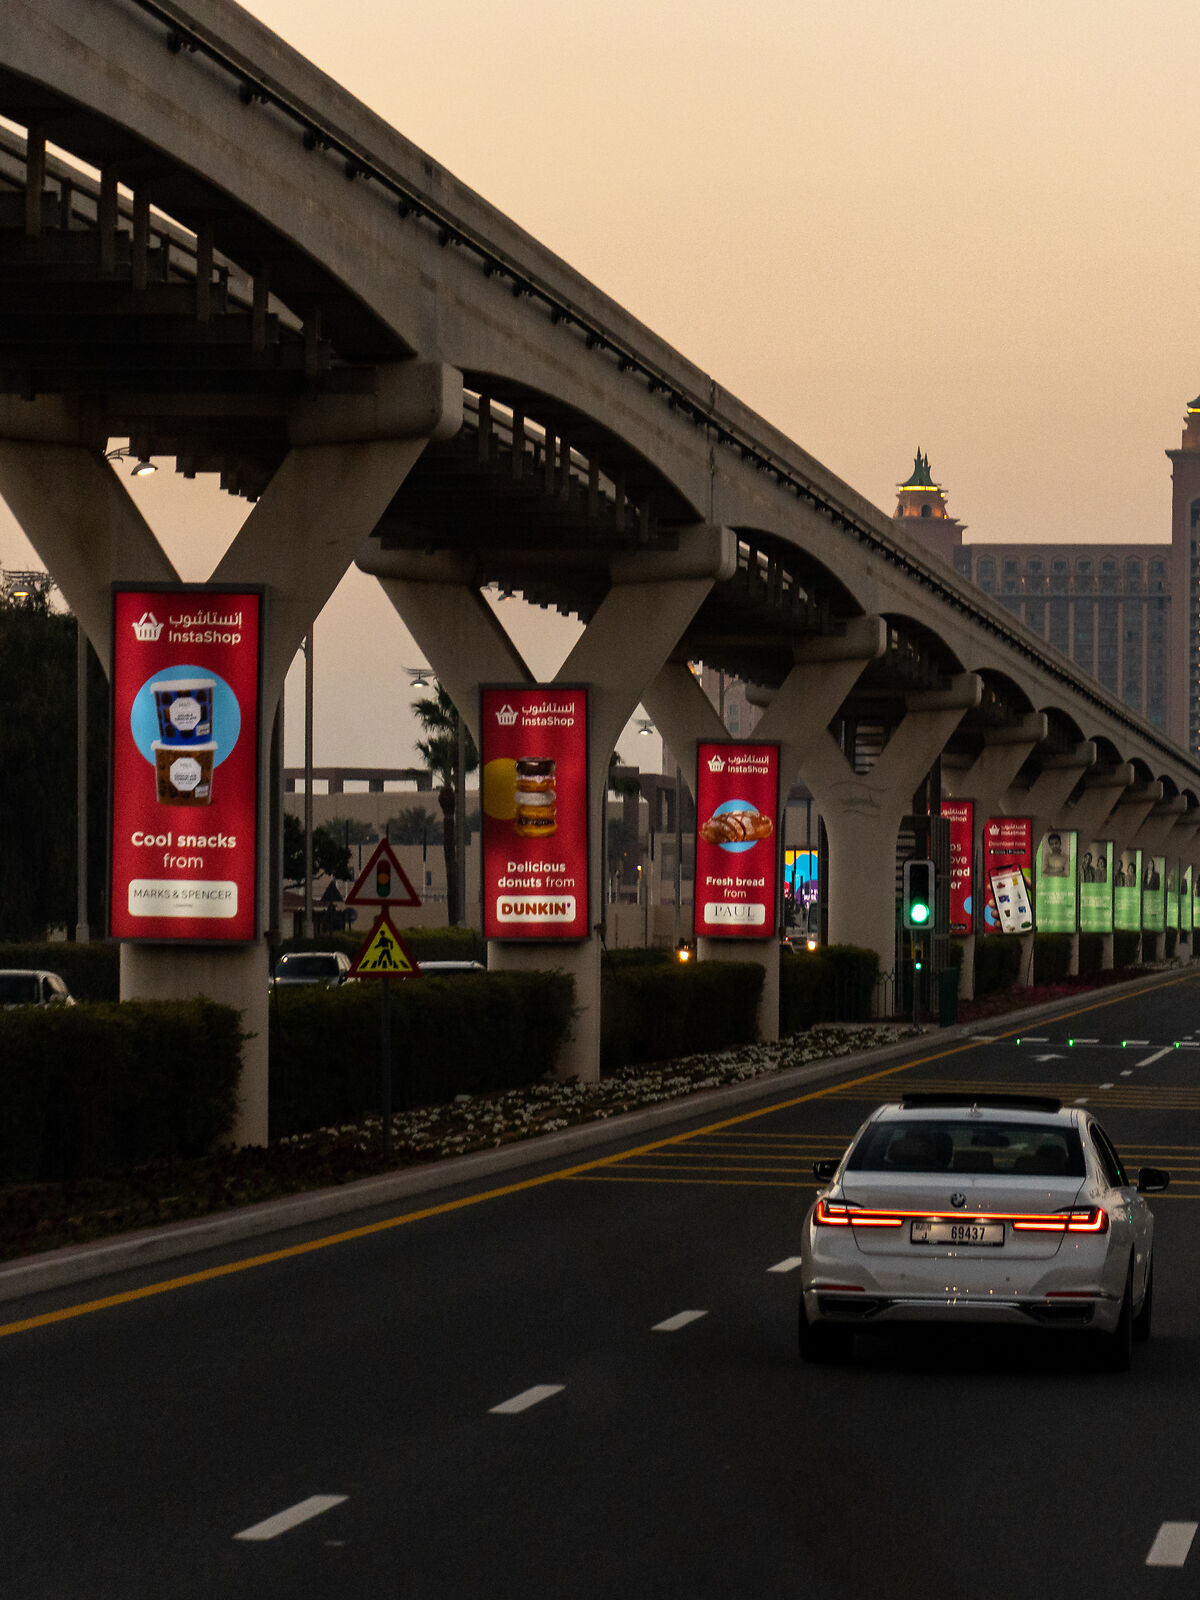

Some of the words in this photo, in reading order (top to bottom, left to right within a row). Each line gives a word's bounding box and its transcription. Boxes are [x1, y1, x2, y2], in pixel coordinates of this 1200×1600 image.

[168, 609, 243, 630] إنستاشوب
[168, 630, 242, 646] InstaShop
[521, 716, 575, 728] InstaShop
[727, 764, 769, 775] InstaShop
[131, 831, 172, 847] Cool
[177, 832, 237, 849] snacks
[163, 852, 204, 869] from
[507, 861, 566, 873] Delicious
[497, 875, 542, 889] donuts
[545, 876, 575, 888] from
[706, 876, 734, 887] Fresh
[735, 876, 765, 887] bread
[133, 888, 171, 900] MARKS
[172, 889, 180, 901] &
[181, 889, 233, 901] SPENCER
[723, 888, 747, 899] from
[501, 902, 571, 915] DUNKIN'
[714, 904, 755, 918] PAUL
[951, 1225, 985, 1240] 69437
